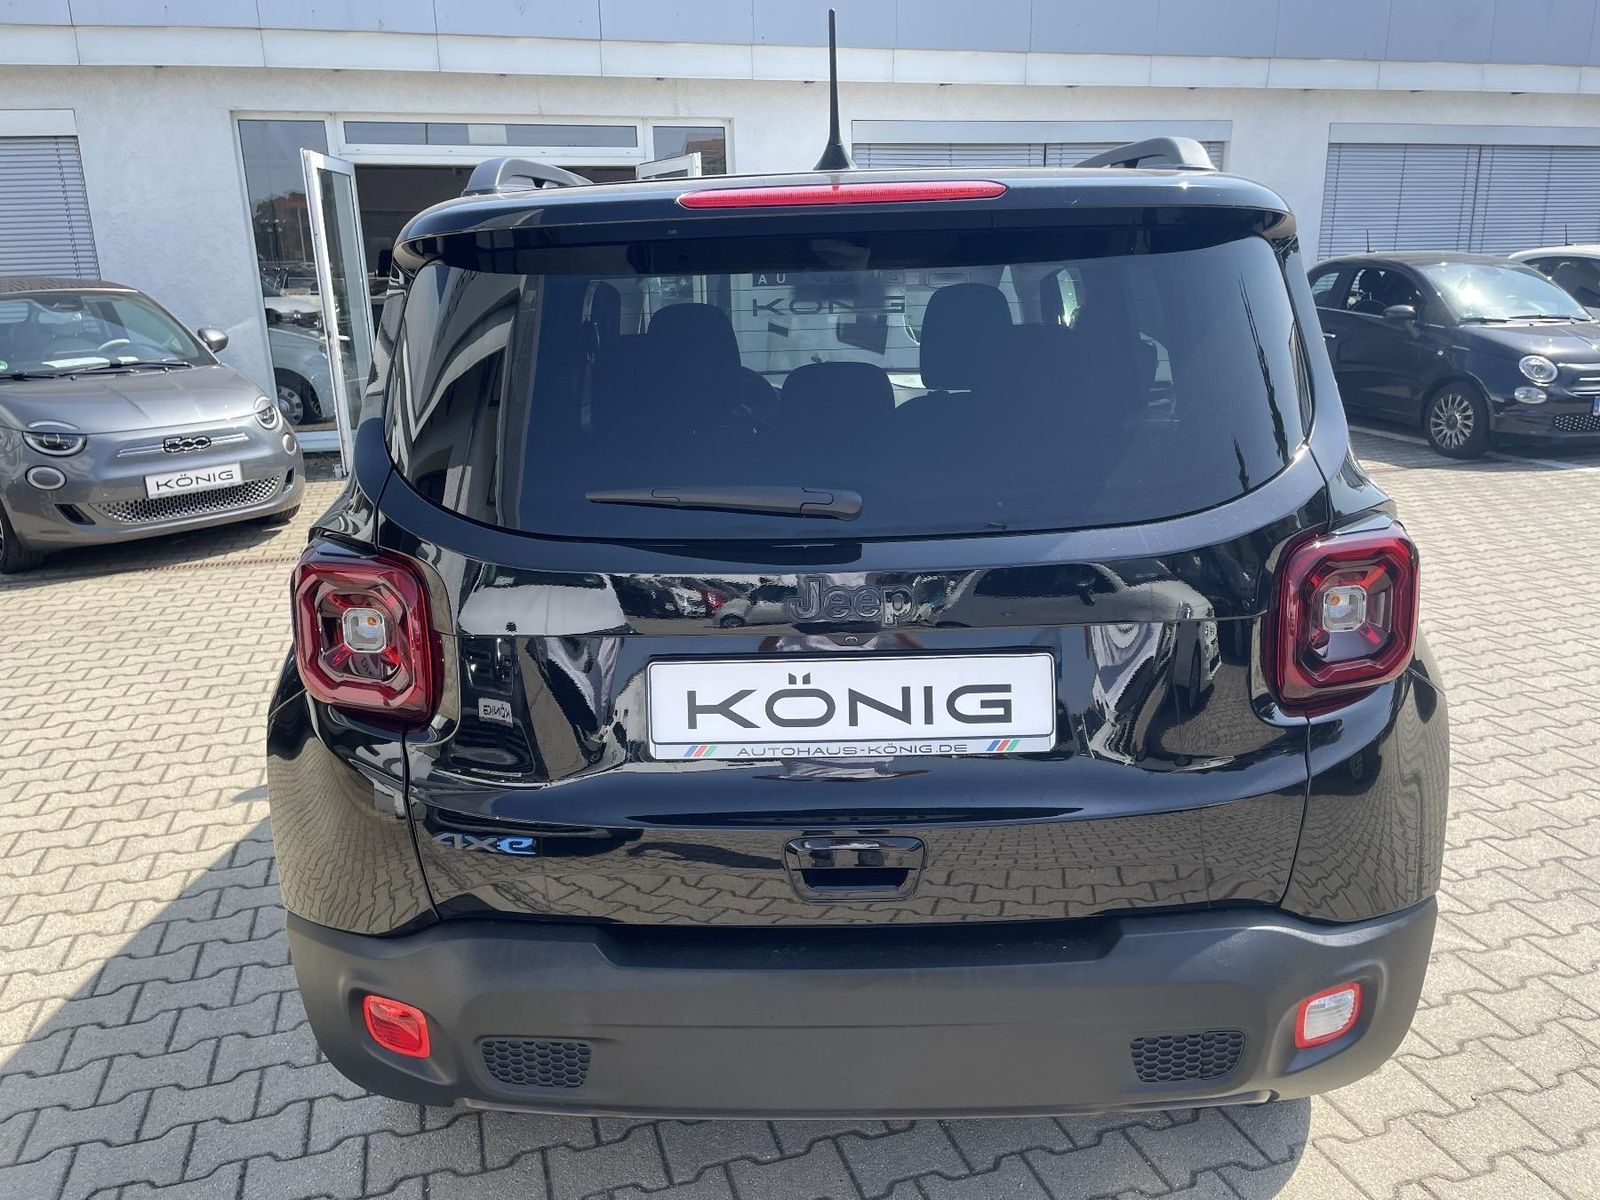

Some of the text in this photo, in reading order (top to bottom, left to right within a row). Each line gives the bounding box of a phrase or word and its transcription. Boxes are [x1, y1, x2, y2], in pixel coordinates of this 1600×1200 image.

[163, 436, 212, 453] 500
[156, 470, 234, 491] KÖNIG
[785, 576, 914, 629] Jeep
[687, 672, 1013, 730] KÖNIG
[737, 743, 968, 758] AUTOHAUS-KÖNIG.DE
